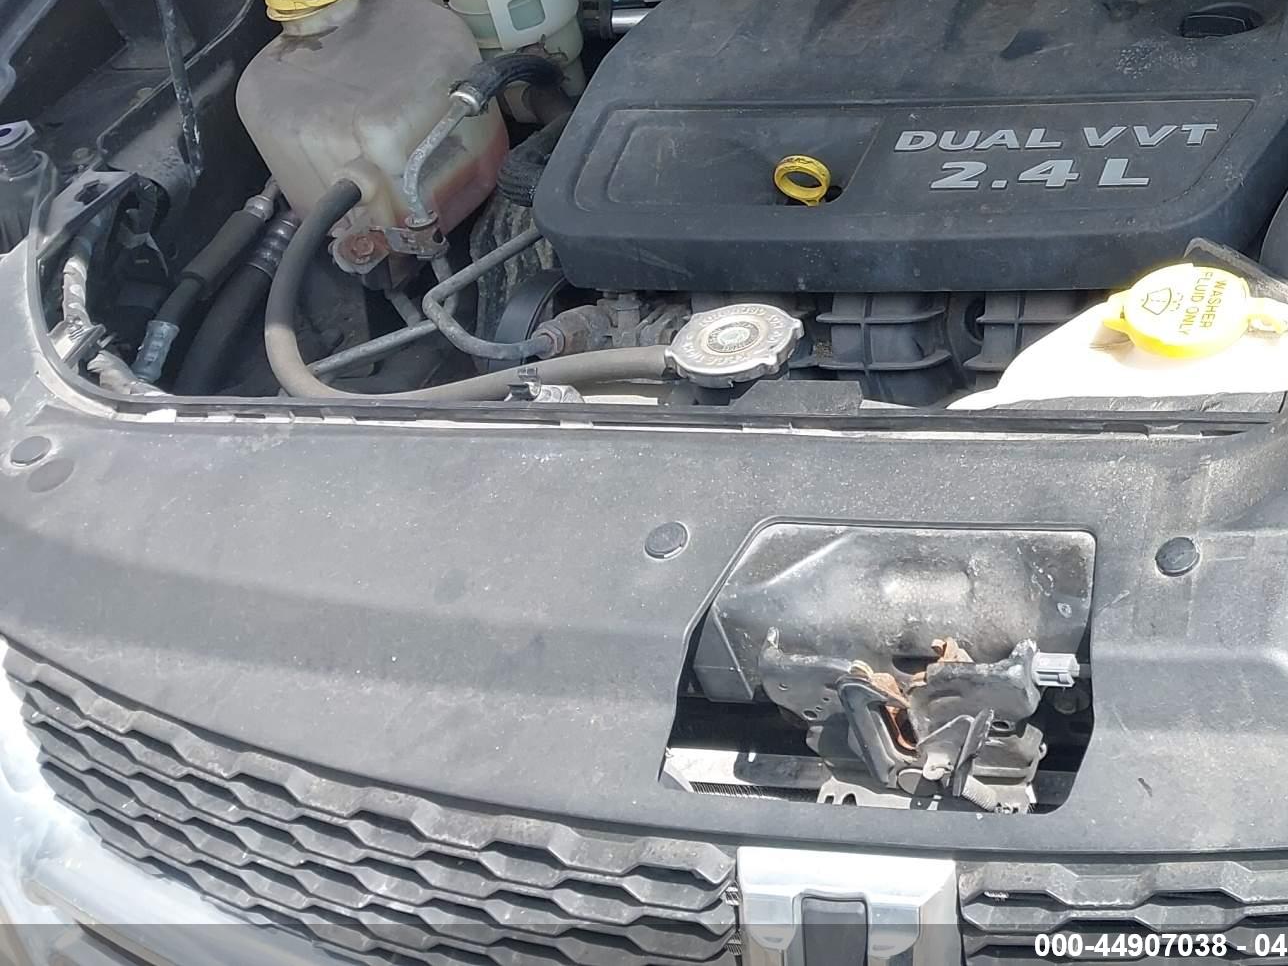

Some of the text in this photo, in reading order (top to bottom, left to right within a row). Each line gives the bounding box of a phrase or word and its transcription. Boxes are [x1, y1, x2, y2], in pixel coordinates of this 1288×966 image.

[894, 122, 1219, 152] DUAL VVT
[1178, 272, 1213, 336] FLUID ONLY
[1199, 281, 1227, 329] WASHER
